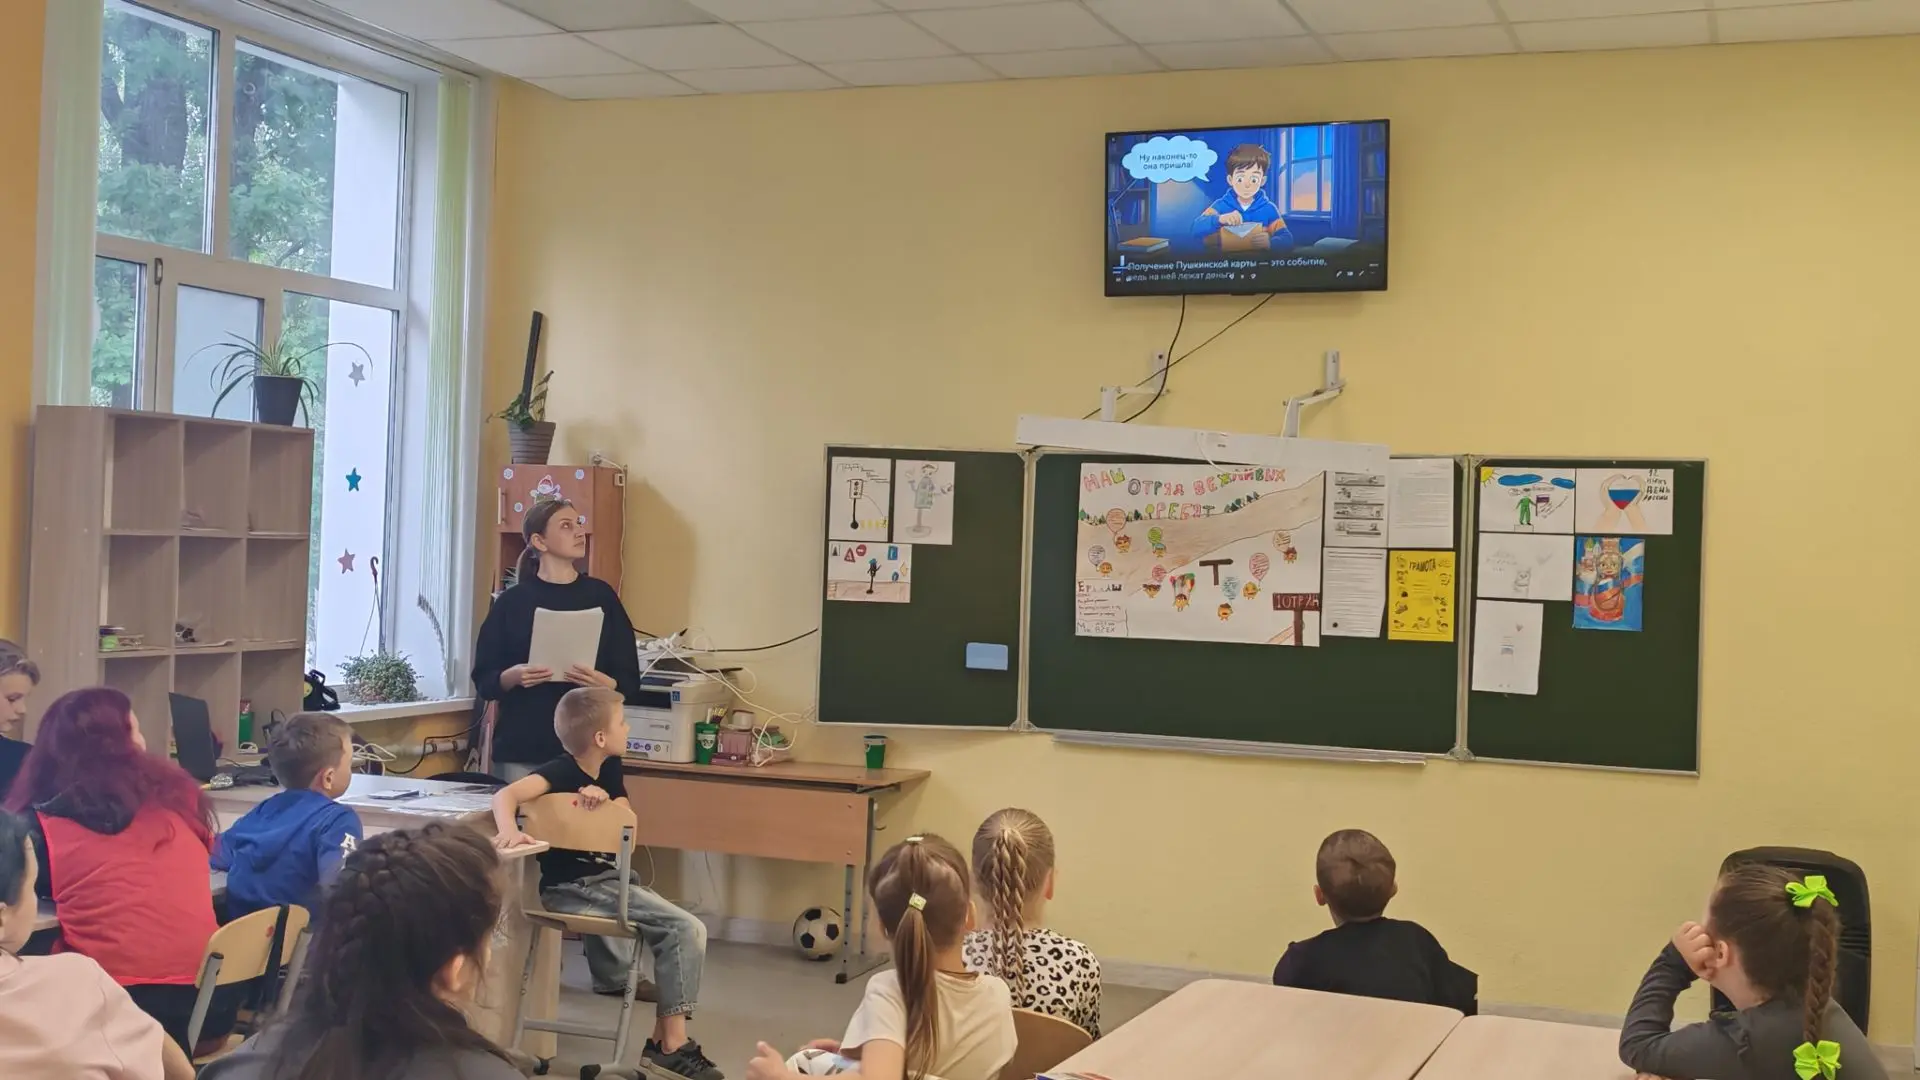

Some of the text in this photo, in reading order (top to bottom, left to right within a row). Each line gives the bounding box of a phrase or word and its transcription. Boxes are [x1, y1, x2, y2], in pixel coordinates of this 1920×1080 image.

[1140, 154, 1151, 162] Ну
[1176, 260, 1229, 271] Пушкинской
[1231, 260, 1257, 269] карты
[1126, 273, 1147, 282] едь
[1205, 272, 1234, 280] деньг
